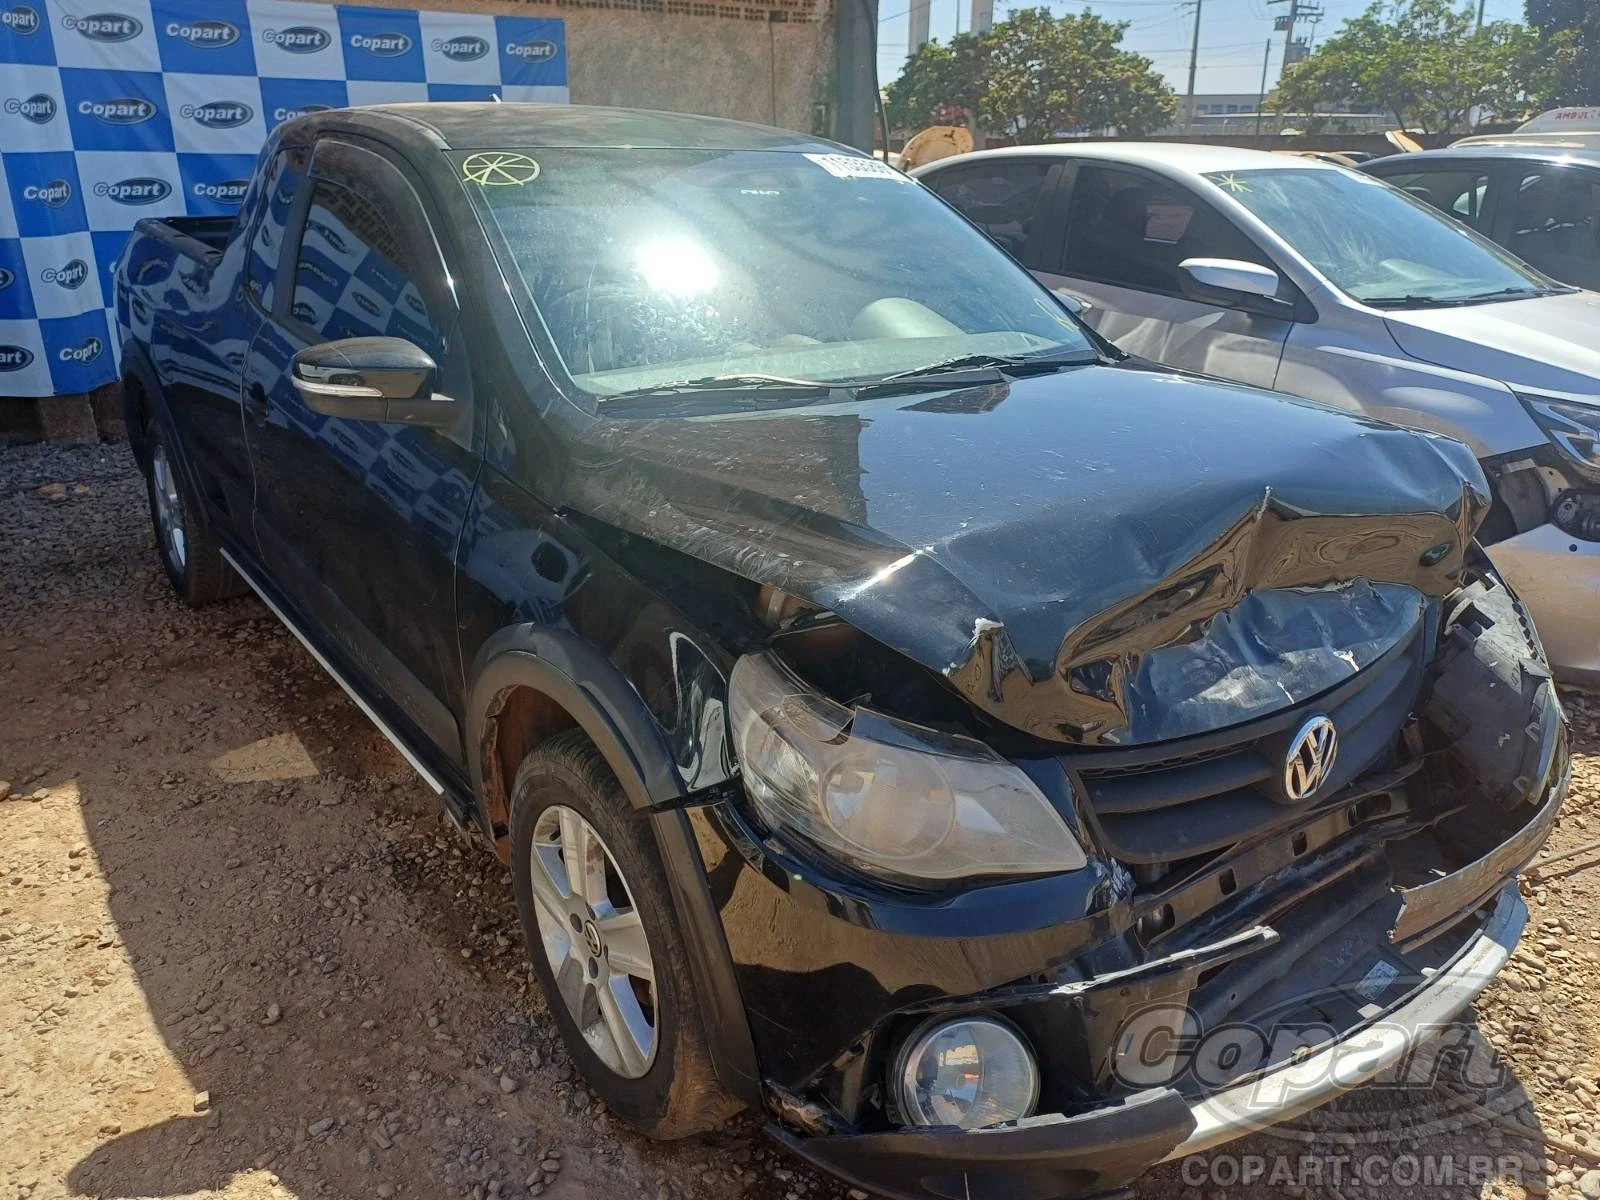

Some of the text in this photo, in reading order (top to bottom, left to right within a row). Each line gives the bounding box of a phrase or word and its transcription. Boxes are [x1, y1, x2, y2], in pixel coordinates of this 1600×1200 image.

[0, 11, 36, 28] opart
[62, 15, 131, 34] Copart
[165, 23, 231, 41] Copart
[263, 30, 322, 47] Copart
[350, 35, 405, 50] Copart
[431, 39, 481, 55] Copart
[505, 43, 551, 58] Copart
[4, 97, 52, 117] Copart
[78, 101, 147, 118] Copart
[180, 104, 245, 122] Copart
[23, 184, 68, 202] Copart
[94, 181, 161, 199] Copart
[193, 182, 248, 198] Copar
[1285, 715, 1338, 801] VW
